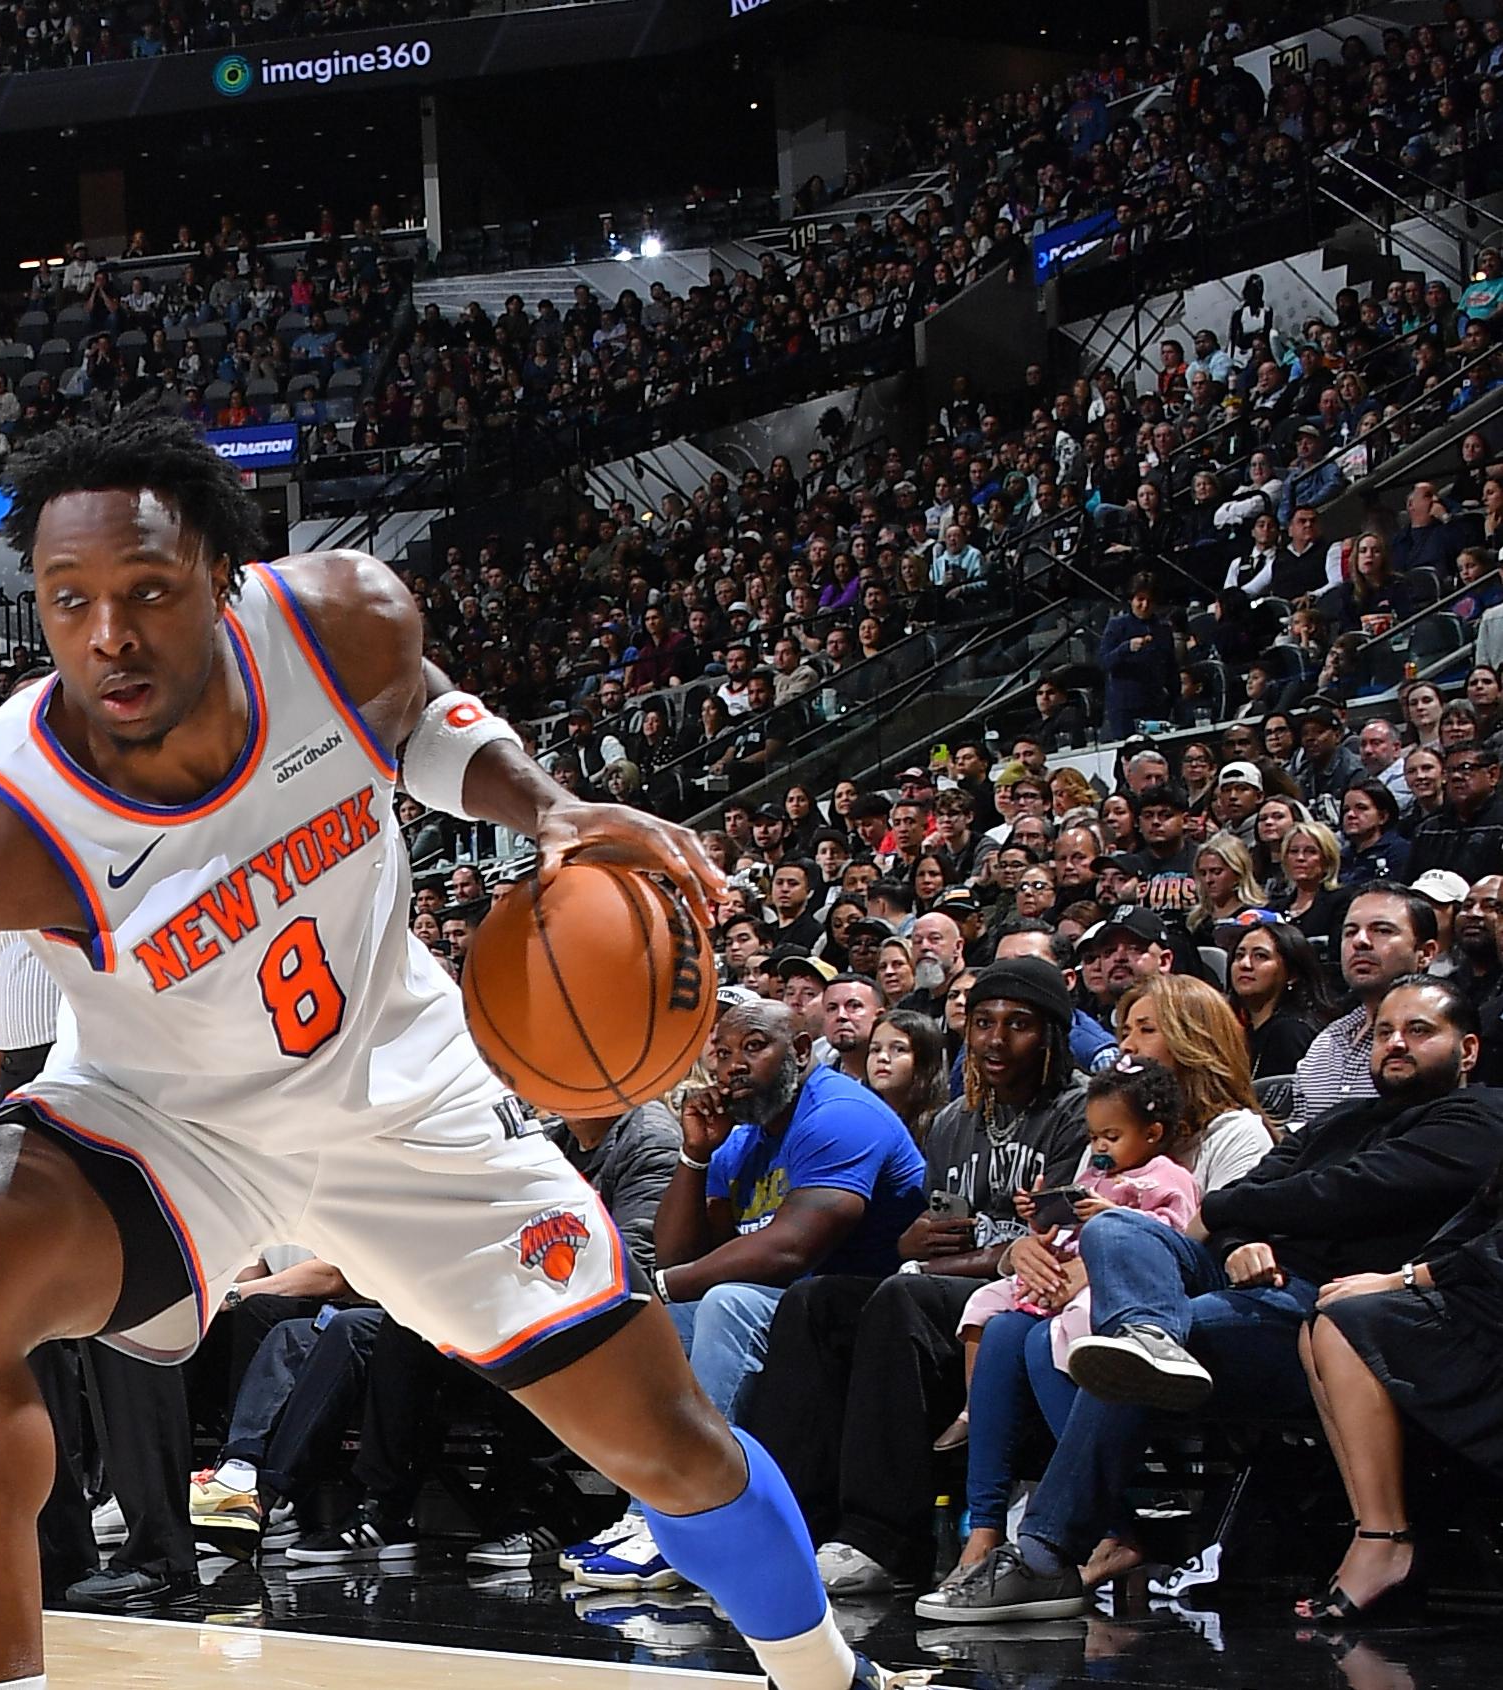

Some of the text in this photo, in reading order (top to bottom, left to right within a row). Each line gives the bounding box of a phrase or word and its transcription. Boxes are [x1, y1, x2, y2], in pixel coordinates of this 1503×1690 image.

[261, 41, 431, 84] imagine360
[790, 223, 816, 250] 119
[207, 438, 293, 458] OCUMATION
[277, 730, 343, 783] abu dhabi
[133, 786, 380, 993] NEW YORK
[257, 915, 346, 1058] 8
